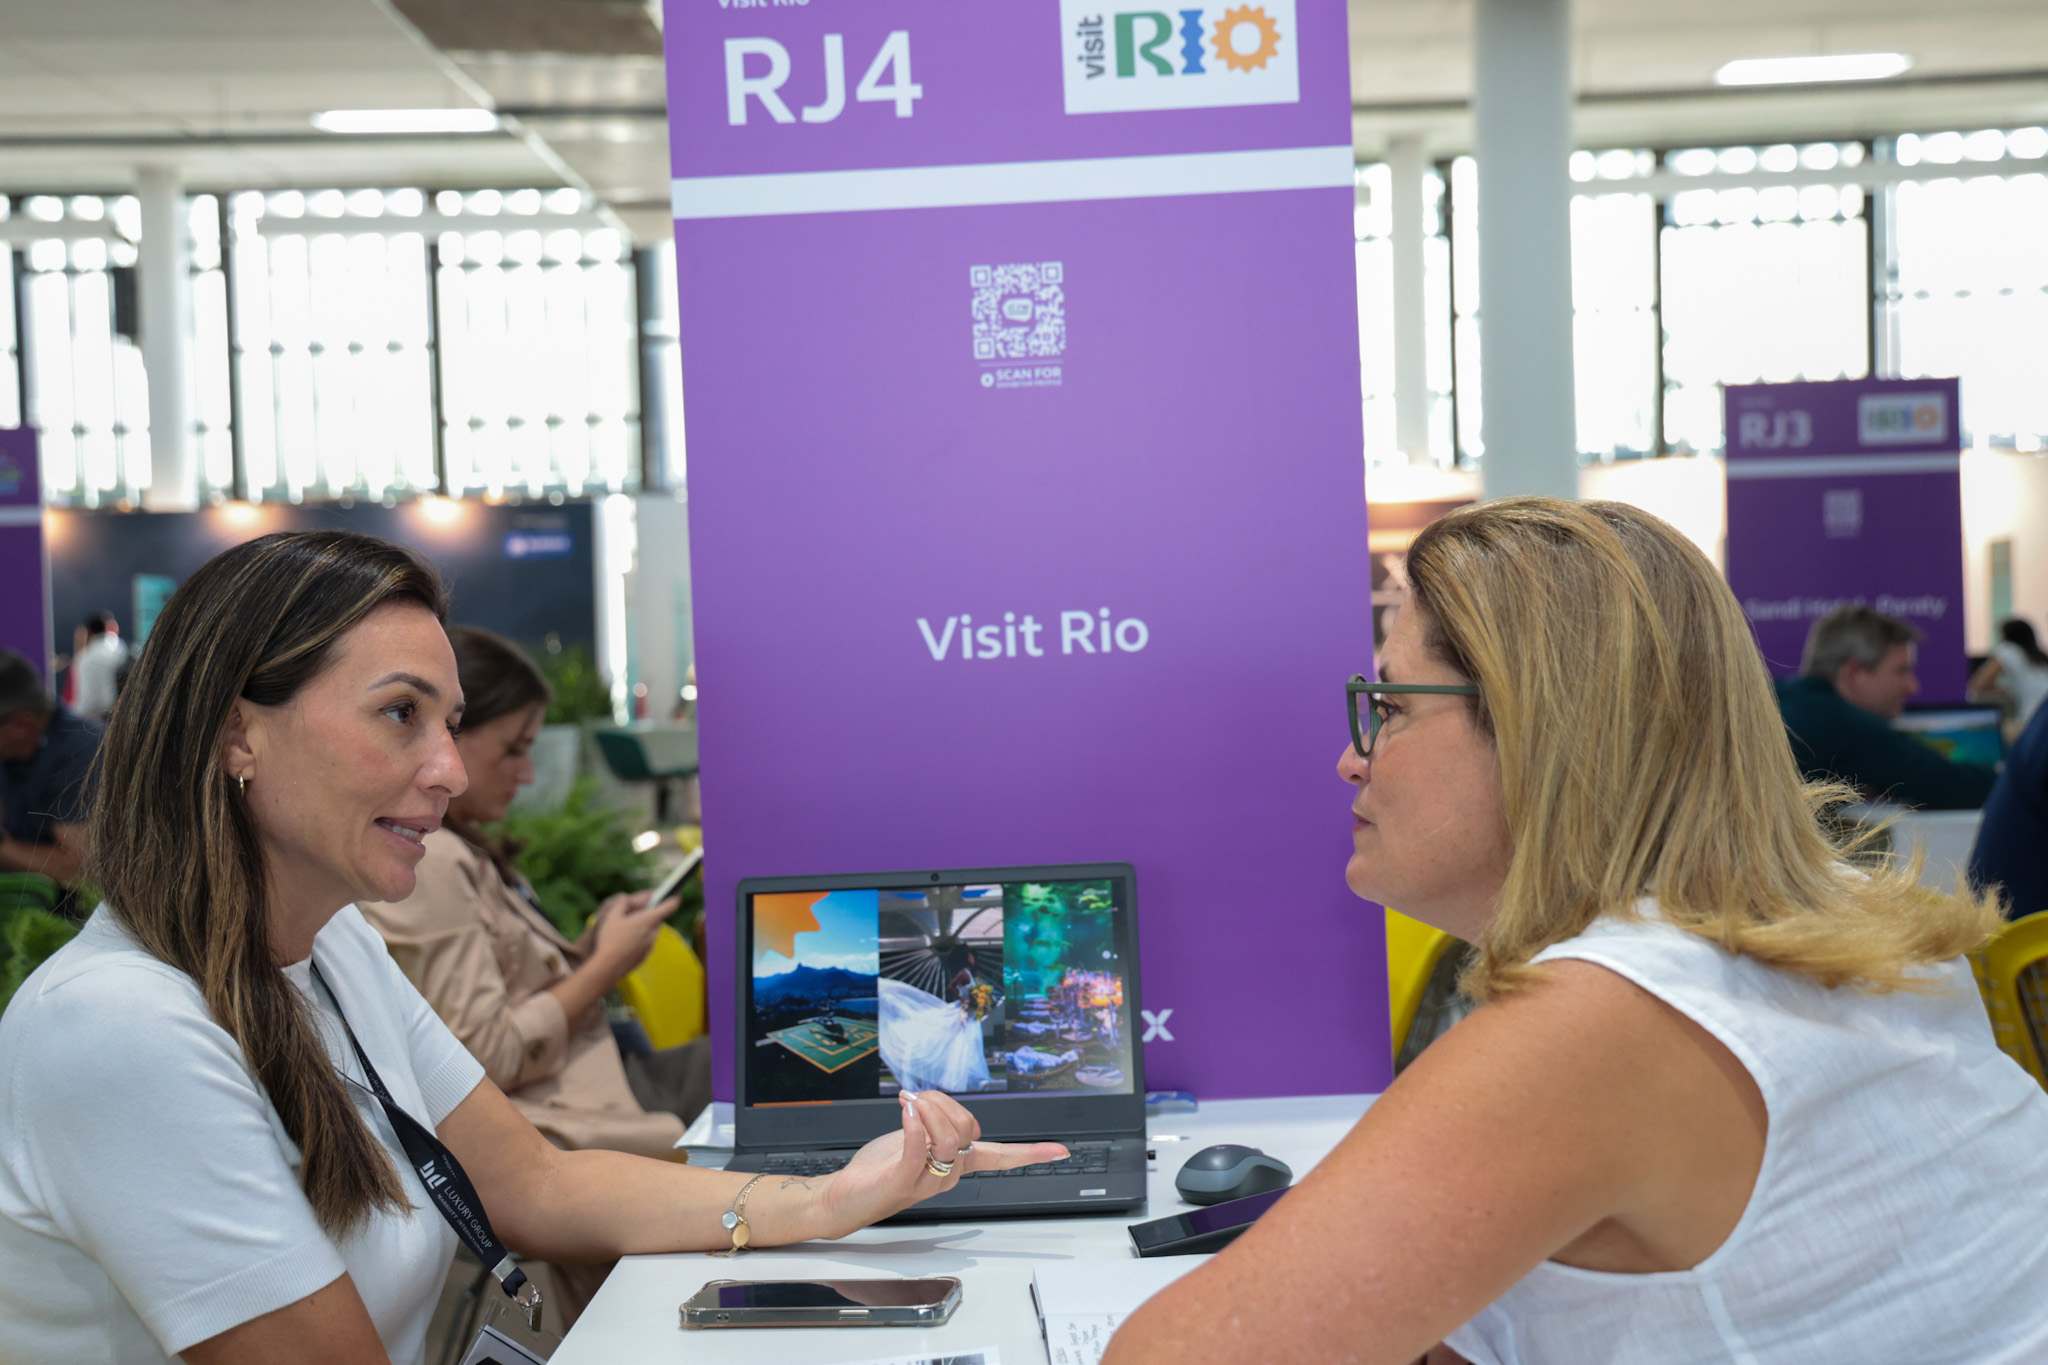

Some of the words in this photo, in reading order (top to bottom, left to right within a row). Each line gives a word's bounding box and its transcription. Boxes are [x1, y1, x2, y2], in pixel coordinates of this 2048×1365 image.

[1077, 14, 1105, 80] visit
[1114, 4, 1282, 78] RIO
[724, 30, 923, 126] RJ4
[996, 368, 1032, 381] SCAN
[1035, 366, 1062, 379] FOR
[1740, 410, 1811, 447] RJ3
[916, 611, 1044, 661] Visit
[1061, 607, 1149, 654] Rio
[437, 1193, 458, 1219] MARRIOTT
[457, 1219, 485, 1255] INTERNATIONAL
[444, 1185, 474, 1220] LUXURY
[470, 1219, 493, 1248] GROUP
